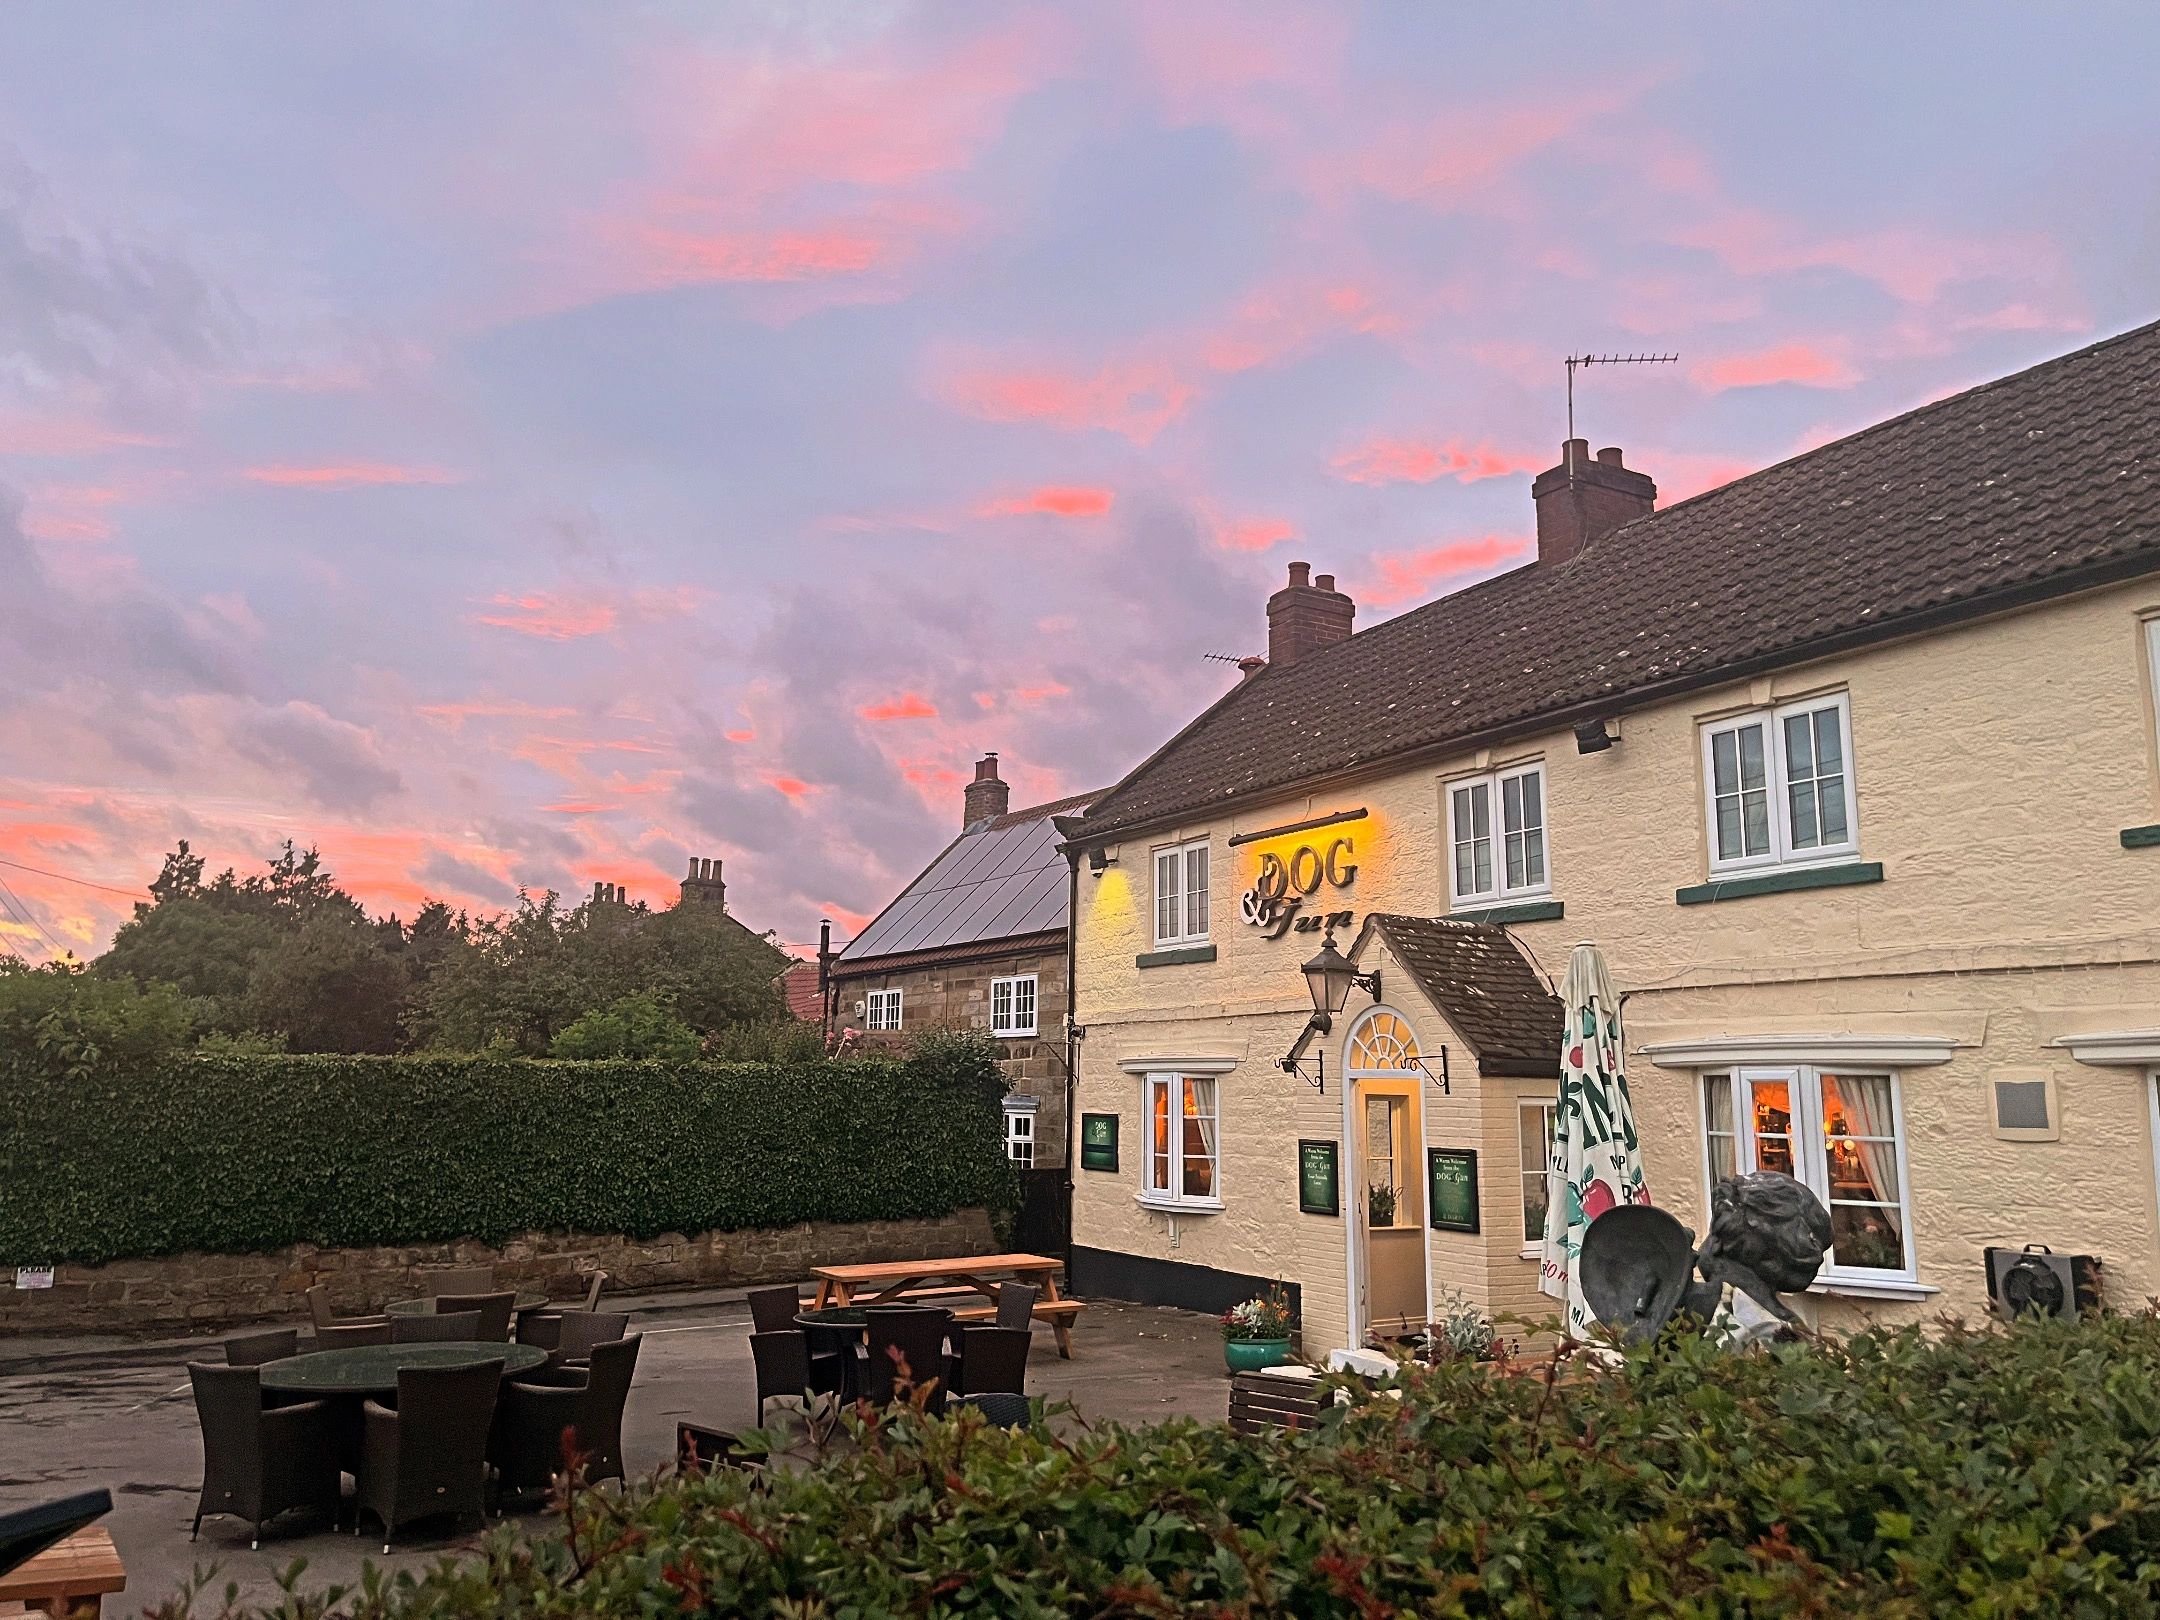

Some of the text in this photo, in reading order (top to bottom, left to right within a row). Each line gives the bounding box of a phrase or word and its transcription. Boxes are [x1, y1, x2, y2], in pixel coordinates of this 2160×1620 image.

[1240, 863, 1273, 927] &
[1258, 837, 1358, 900] DOG
[1436, 1172, 1451, 1181] DOG
